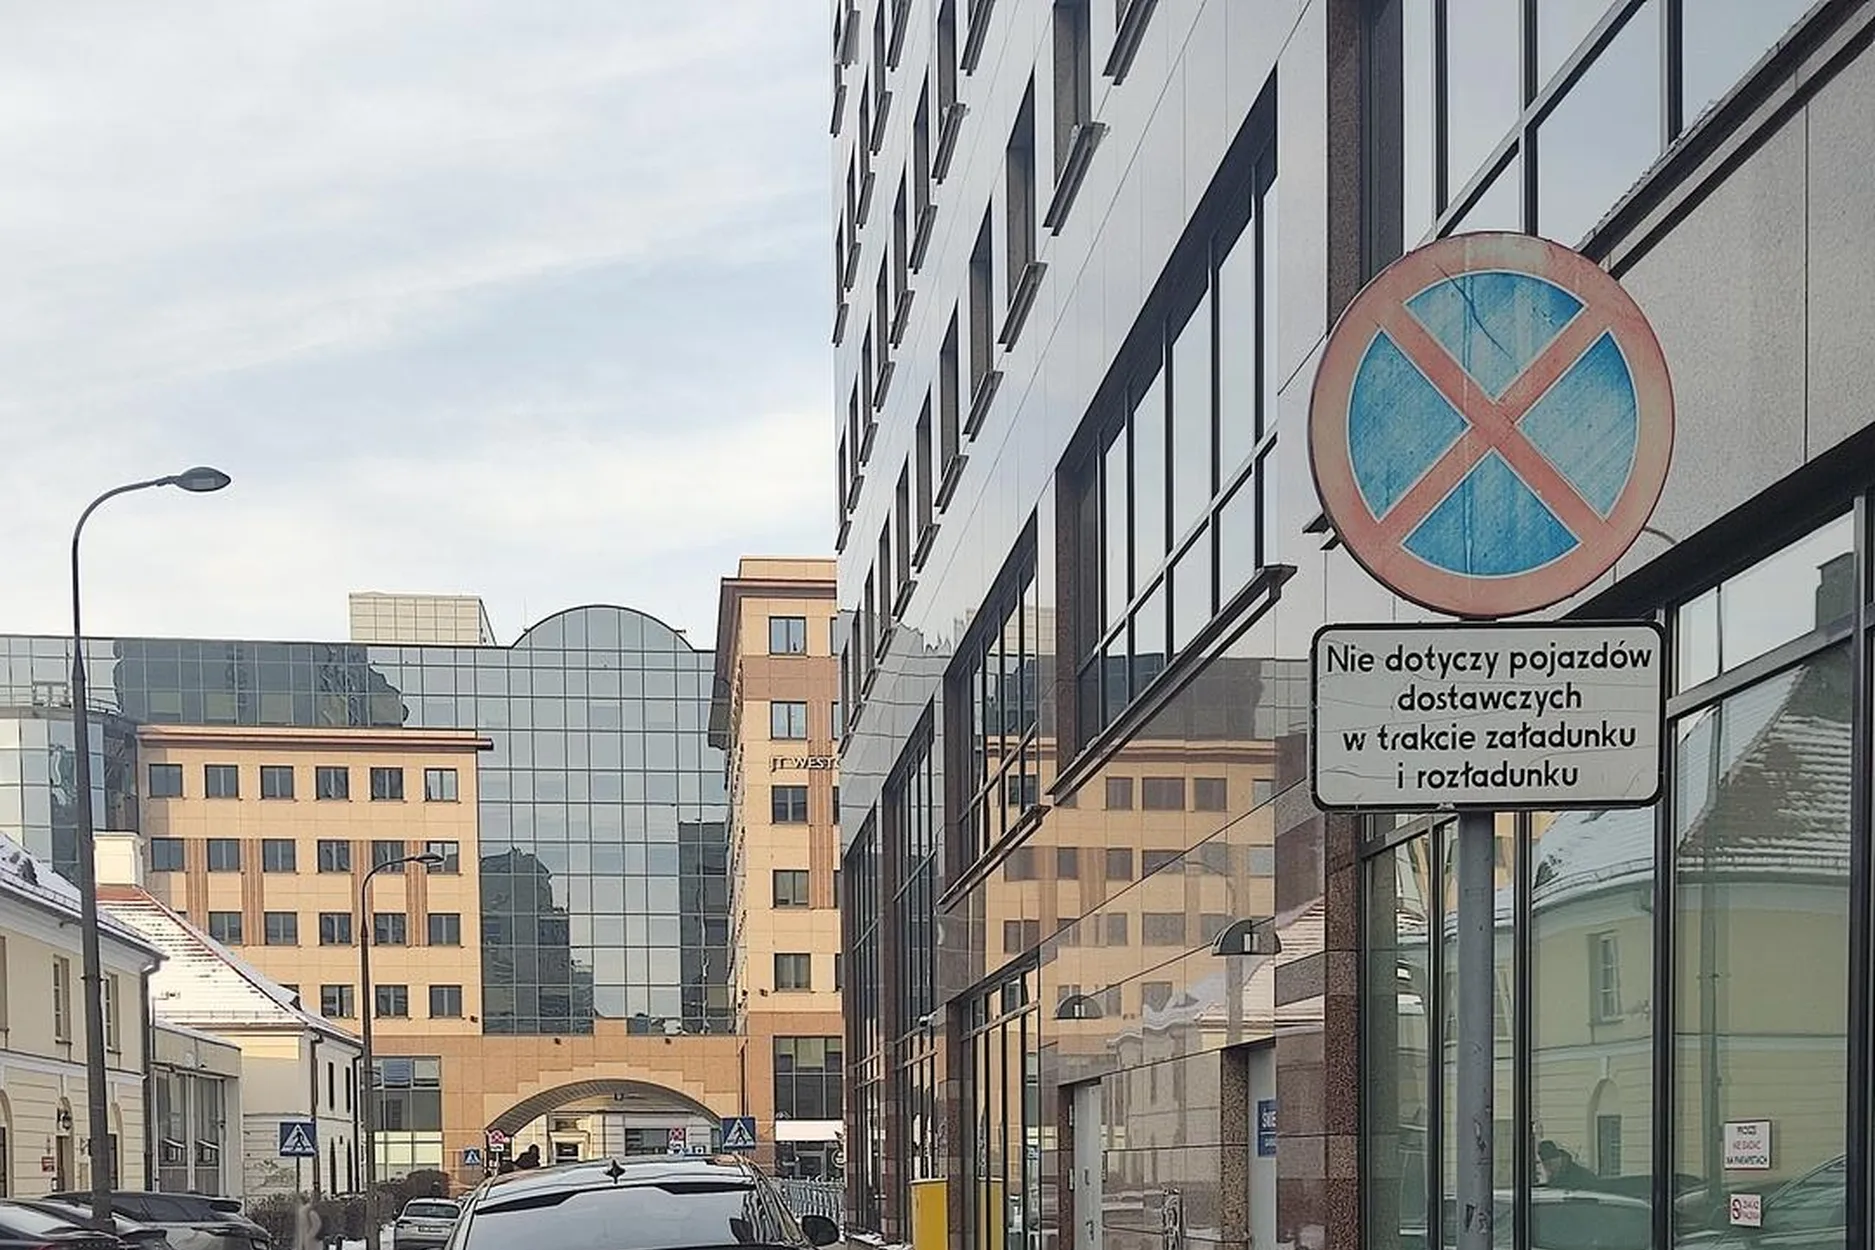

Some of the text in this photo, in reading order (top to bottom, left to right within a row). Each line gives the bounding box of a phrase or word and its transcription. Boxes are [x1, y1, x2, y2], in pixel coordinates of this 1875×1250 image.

[1327, 640, 1652, 679] Nie dotyczy pojazdów
[1397, 682, 1582, 717] dostawczych
[1343, 720, 1636, 751] w trakcie załadunku
[1397, 760, 1578, 789] i rozładunku
